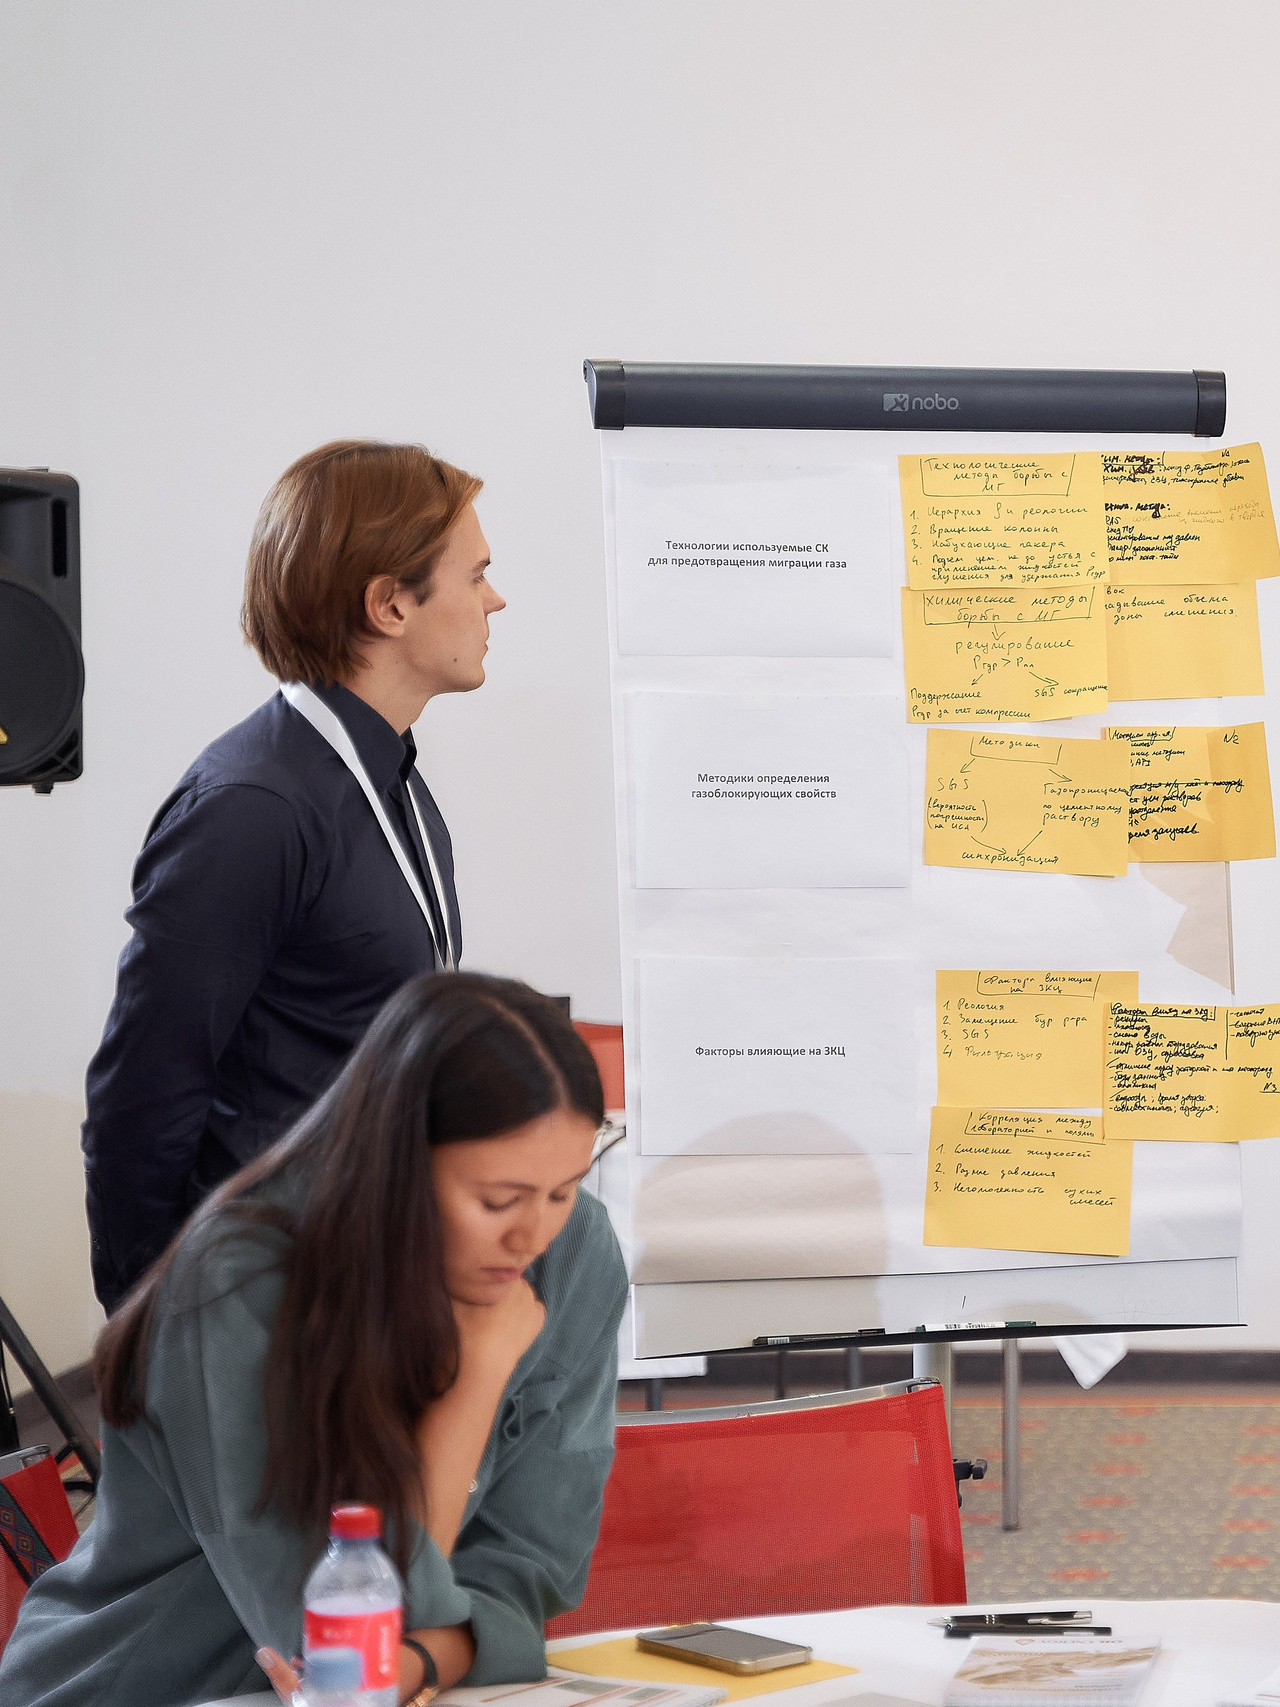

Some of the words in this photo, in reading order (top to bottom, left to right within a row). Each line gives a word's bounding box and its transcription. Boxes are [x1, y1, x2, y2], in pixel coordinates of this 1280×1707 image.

[912, 393, 959, 410] nobo
[1013, 468, 1053, 486] борьбы
[909, 510, 919, 520] 1.
[910, 525, 920, 535] 2.
[929, 526, 992, 538] Вращение
[665, 540, 730, 552] Технологии
[732, 542, 812, 554] используемые
[815, 544, 829, 552] СК
[911, 540, 922, 549] 3.
[647, 557, 668, 567] для
[671, 558, 766, 568] предотвращения
[768, 560, 822, 569] миграции
[825, 560, 847, 568] газа
[957, 608, 1000, 628] борьбы
[955, 637, 1075, 656] регулирование
[910, 688, 982, 706] Поддержание
[697, 774, 754, 784] Методики
[756, 774, 830, 785] определения
[691, 789, 792, 800] газоблокирующих
[795, 788, 837, 799] свойств
[943, 1001, 951, 1010] 1.
[956, 998, 1005, 1011] Реология
[942, 1016, 951, 1026] 2.
[695, 1045, 745, 1058] Факторы
[747, 1047, 806, 1057] влияющие
[809, 1047, 822, 1056] на
[824, 1046, 847, 1058] ЗКЦ
[935, 1144, 945, 1155] 1.
[934, 1163, 945, 1174] 2.
[933, 1182, 942, 1192] 3.
